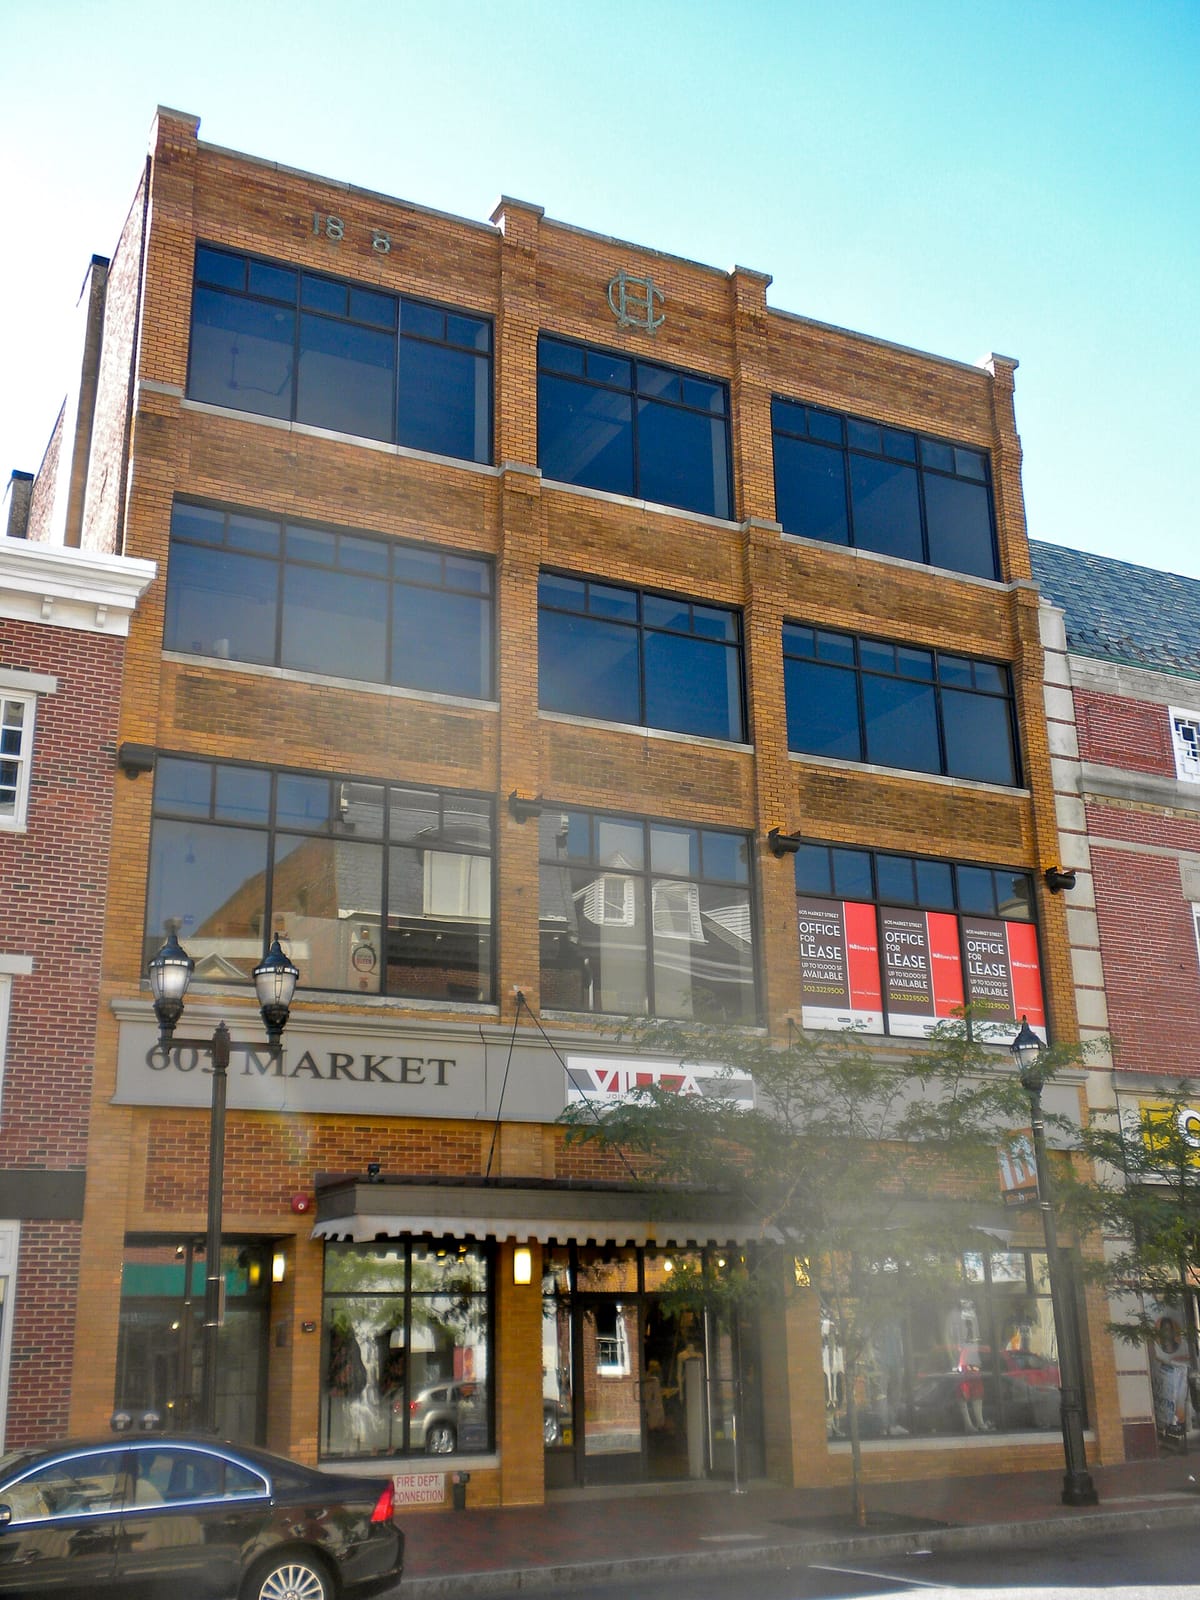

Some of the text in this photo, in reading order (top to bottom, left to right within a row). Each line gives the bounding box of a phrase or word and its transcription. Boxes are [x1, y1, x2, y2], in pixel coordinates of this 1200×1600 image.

[799, 922, 841, 936] OFFICE
[800, 934, 815, 943] FOR
[885, 932, 925, 946] OFFICE
[800, 943, 842, 960] LEASE
[886, 943, 901, 952] FOR
[967, 940, 1005, 955] OFFICE
[887, 953, 927, 969] LEASE
[968, 952, 982, 961] FOR
[802, 970, 844, 981] AVAILABLE
[969, 961, 1007, 977] LEASE
[889, 978, 928, 990] AVAILABLE
[971, 986, 1009, 997] AVAILABLE
[239, 1049, 457, 1086] MARKET
[396, 1476, 415, 1488] FIRE
[394, 1490, 443, 1503] CONNECTION
